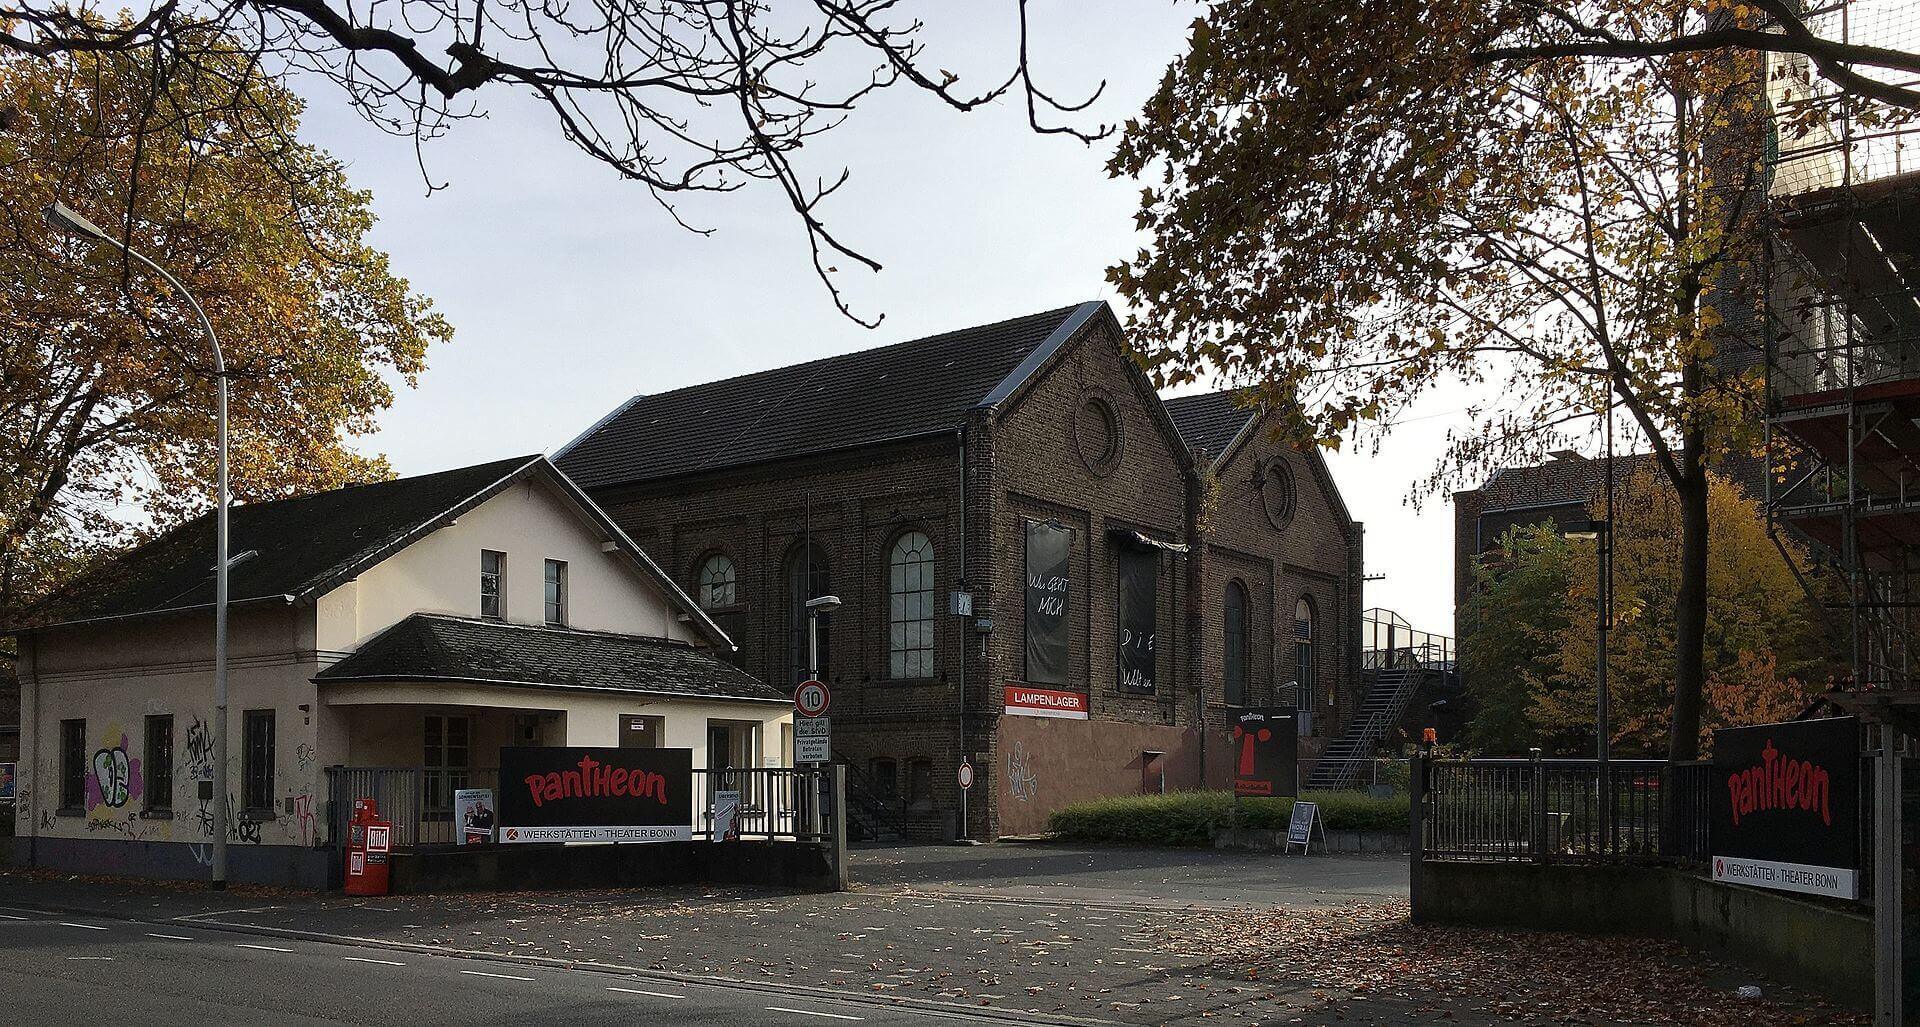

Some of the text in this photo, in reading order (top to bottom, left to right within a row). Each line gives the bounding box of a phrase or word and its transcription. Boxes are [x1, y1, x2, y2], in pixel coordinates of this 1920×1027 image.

[804, 690, 820, 707] 10
[1014, 692, 1080, 708] LAMPENLAGER
[370, 830, 386, 847] Bild
[523, 829, 597, 839] WERKSTÄTTEN
[605, 829, 647, 838] THEATER
[649, 829, 677, 838] BONN
[1726, 863, 1776, 881] WERKSTÄTTEN
[1780, 868, 1814, 887] THEATER
[1815, 873, 1839, 890] BONN
